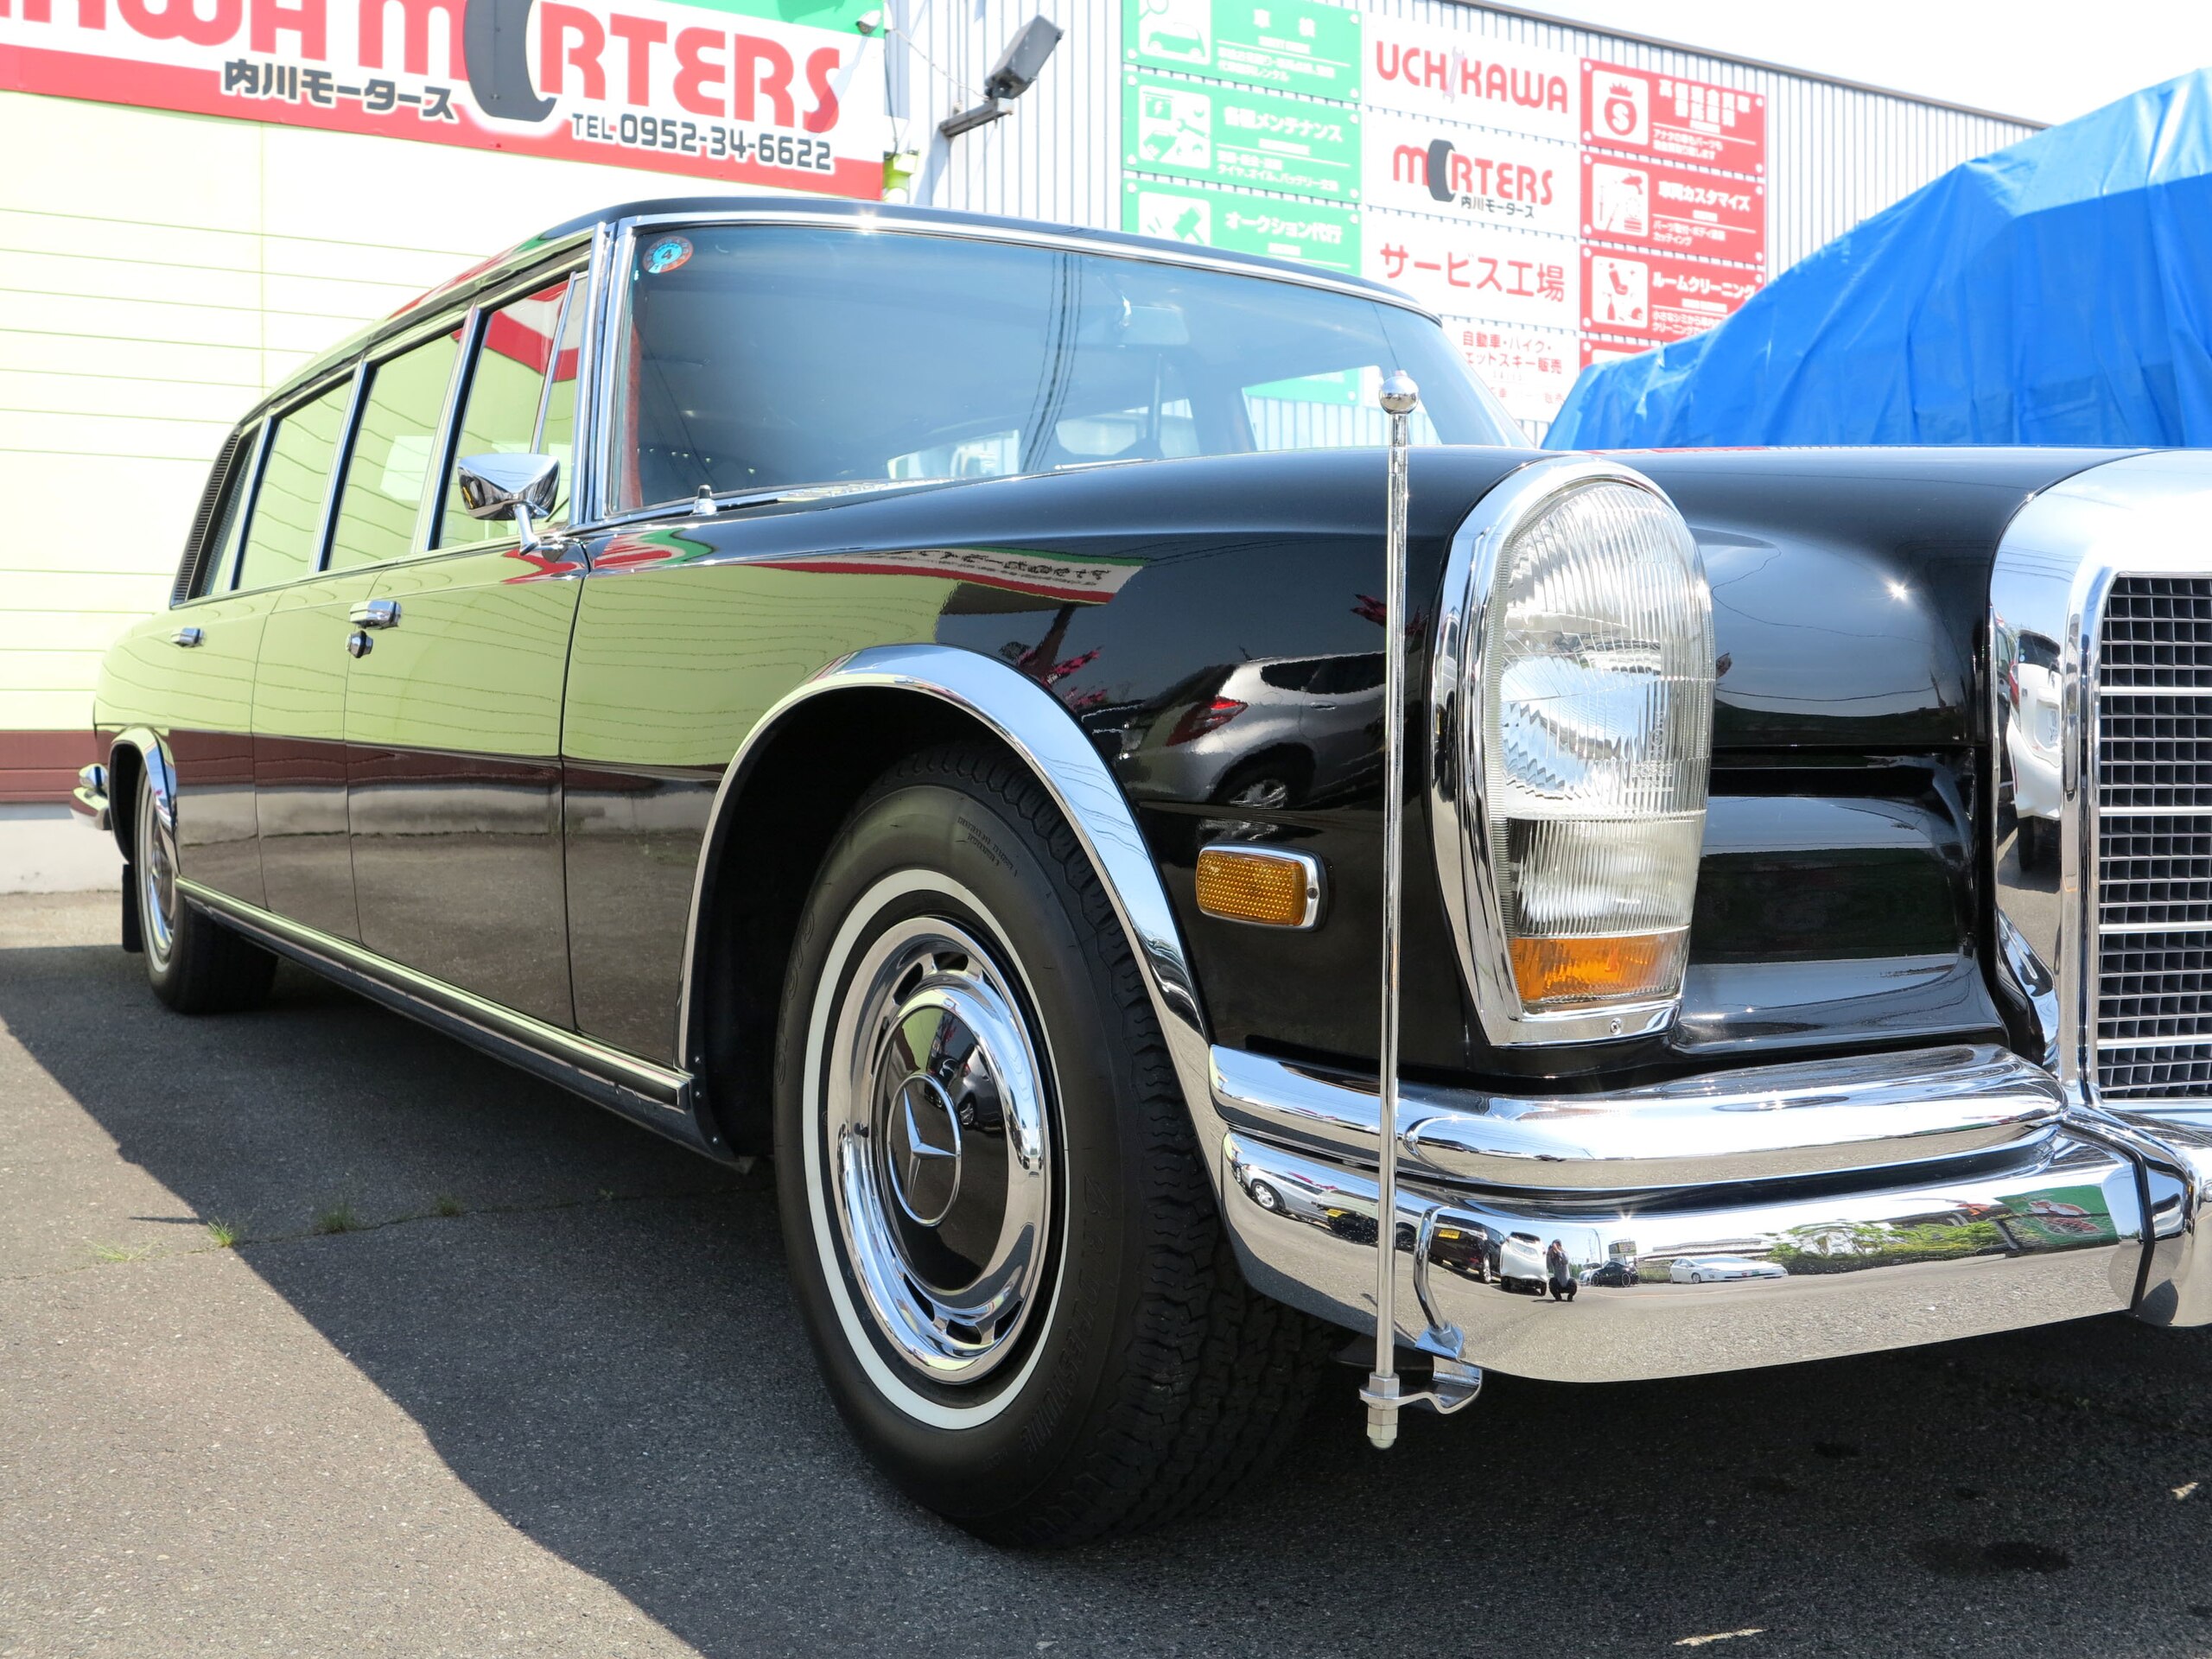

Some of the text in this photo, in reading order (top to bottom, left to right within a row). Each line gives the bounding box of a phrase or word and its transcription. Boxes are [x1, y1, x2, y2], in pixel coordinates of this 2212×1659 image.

[224, 59, 456, 121] 内川モータース
[620, 113, 831, 170] 0952-34-6622
[1224, 210, 1344, 245] オークション代行
[1460, 195, 1535, 220] 内川モータース
[1380, 243, 1565, 303] サービス工場
